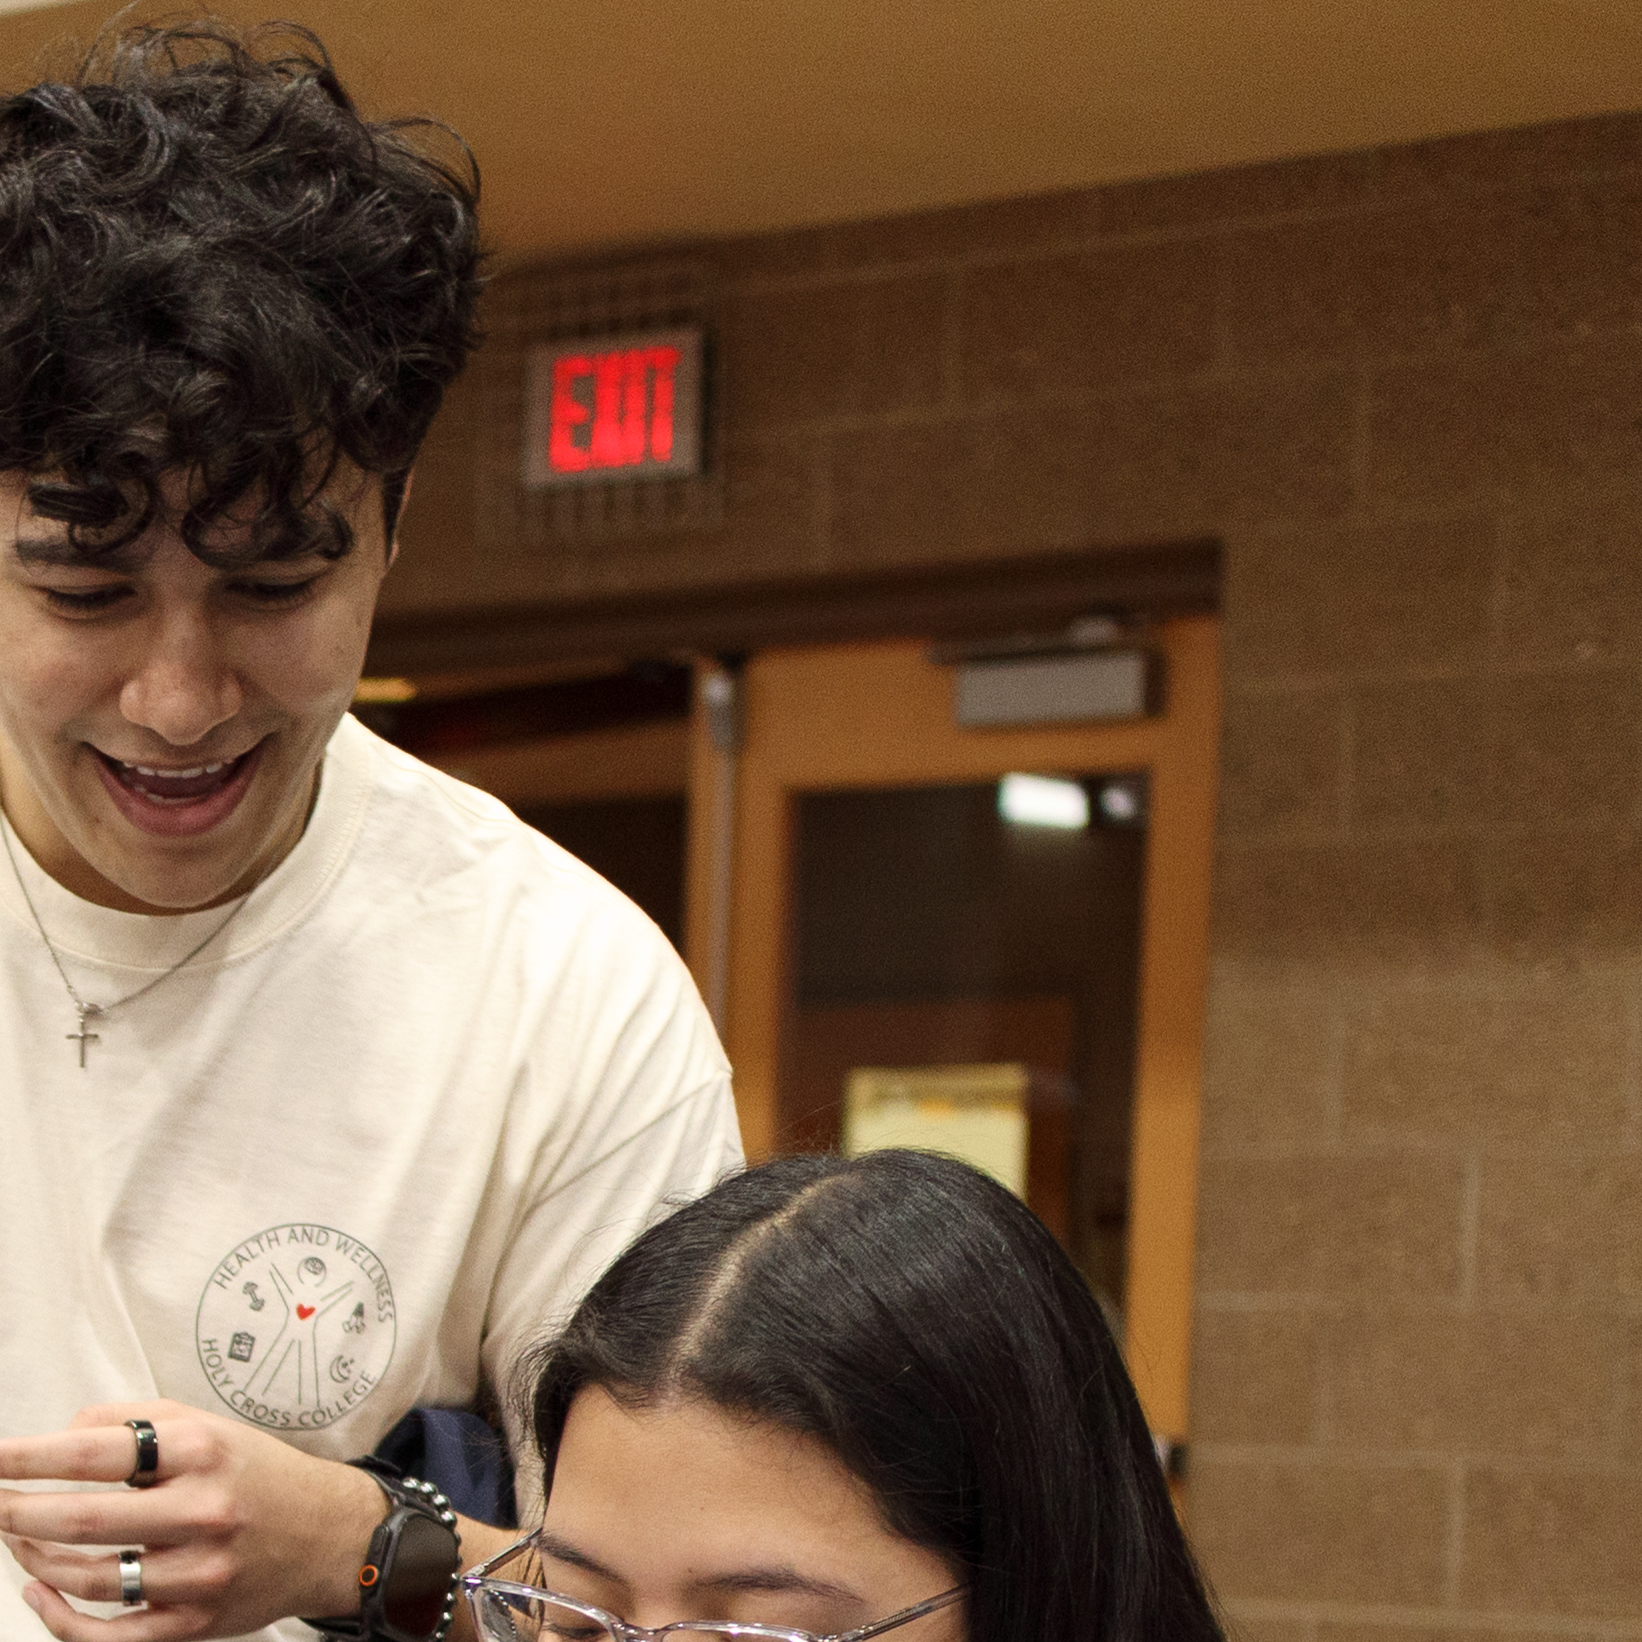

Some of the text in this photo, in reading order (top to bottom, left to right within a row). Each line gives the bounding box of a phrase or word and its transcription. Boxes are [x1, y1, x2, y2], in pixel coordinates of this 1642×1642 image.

[549, 346, 680, 473] EXIT
[213, 1225, 394, 1324] HEALTH AND WELLNESS
[201, 1338, 378, 1427] HOLY CROSS COLLEGE
